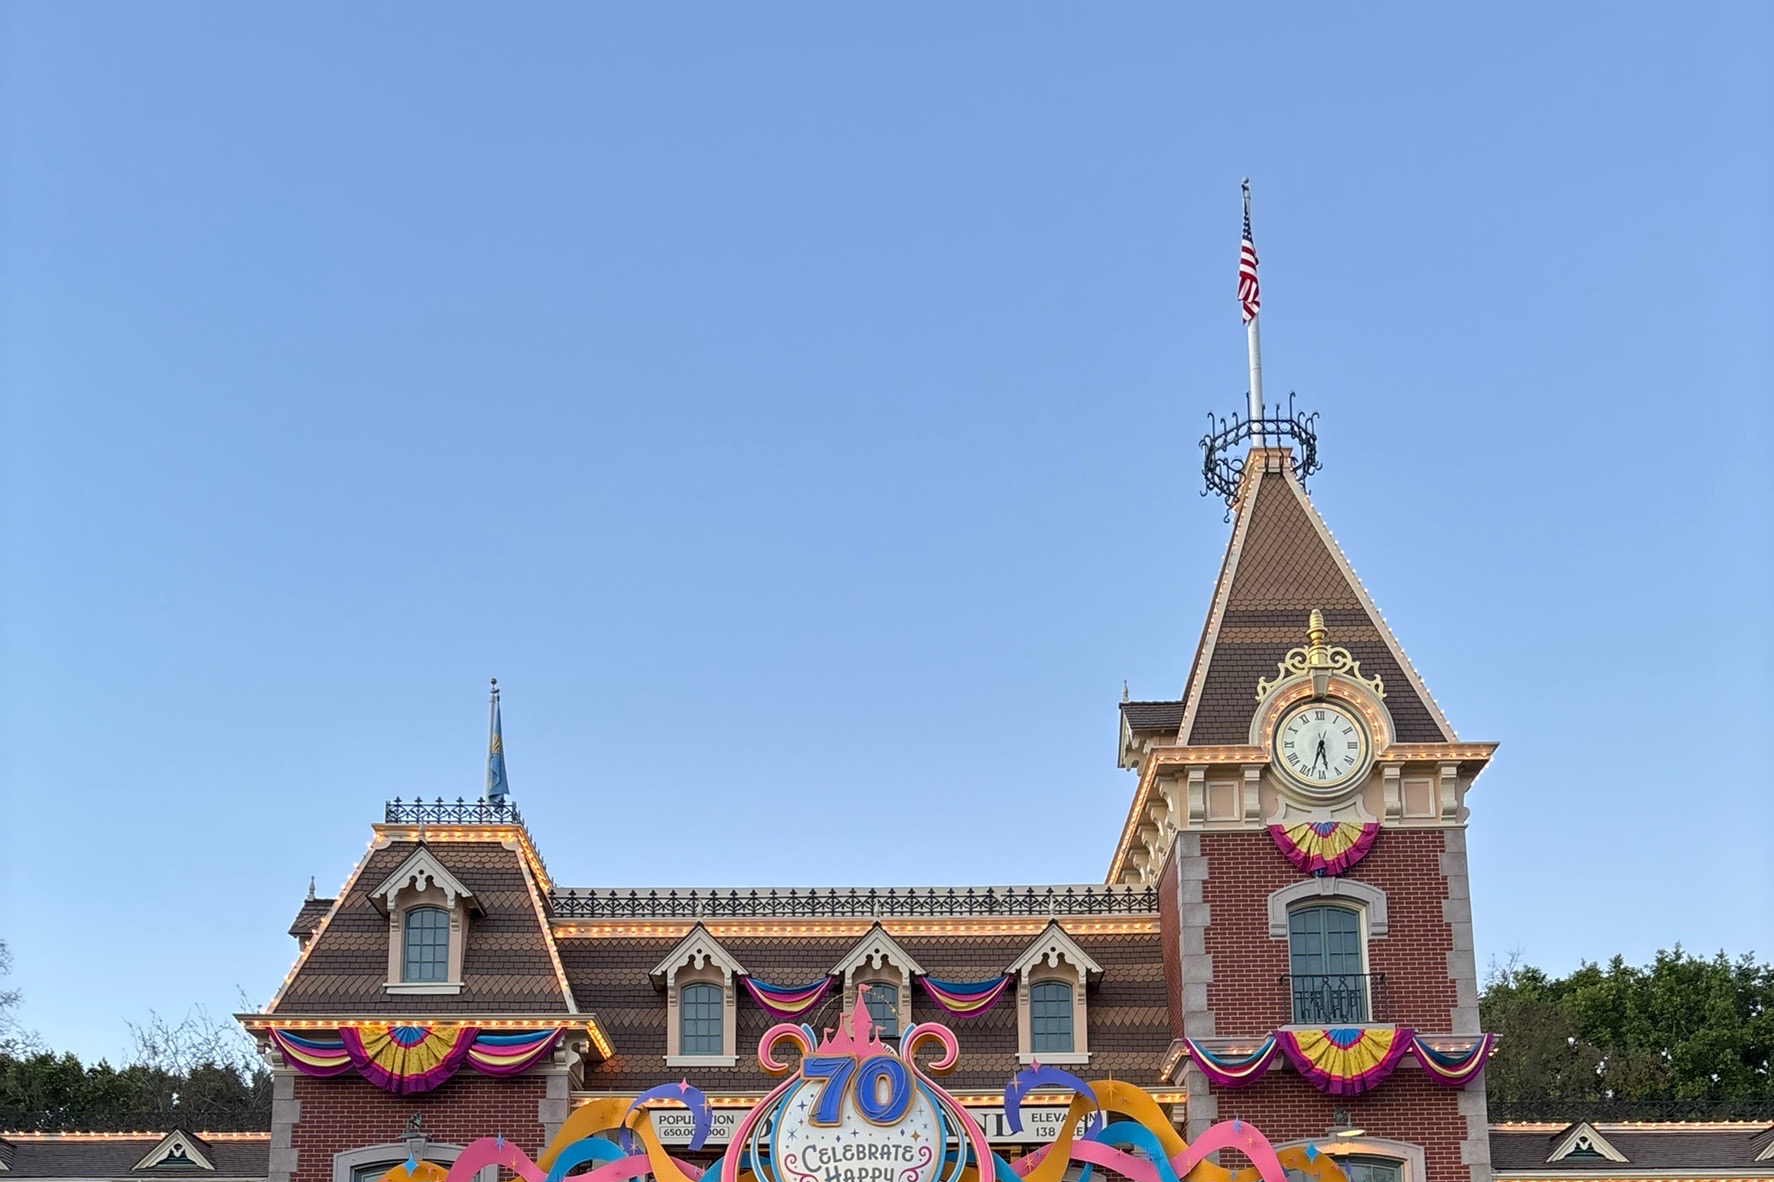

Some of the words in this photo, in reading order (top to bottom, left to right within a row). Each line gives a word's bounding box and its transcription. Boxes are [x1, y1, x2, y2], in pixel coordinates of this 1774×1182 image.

[1299, 714, 1310, 725] XI
[1315, 711, 1325, 720] XII
[1332, 715, 1339, 724] I
[1288, 725, 1299, 734] X
[1342, 726, 1353, 735] II
[1287, 752, 1301, 767] VIII
[1299, 764, 1311, 776] VII
[1318, 770, 1327, 780] VI
[1334, 766, 1342, 776] V
[801, 1053, 916, 1128] 70
[659, 1115, 735, 1125] POPULION
[1031, 1112, 1098, 1123] ELEVAN
[1036, 1126, 1056, 1137] 138
